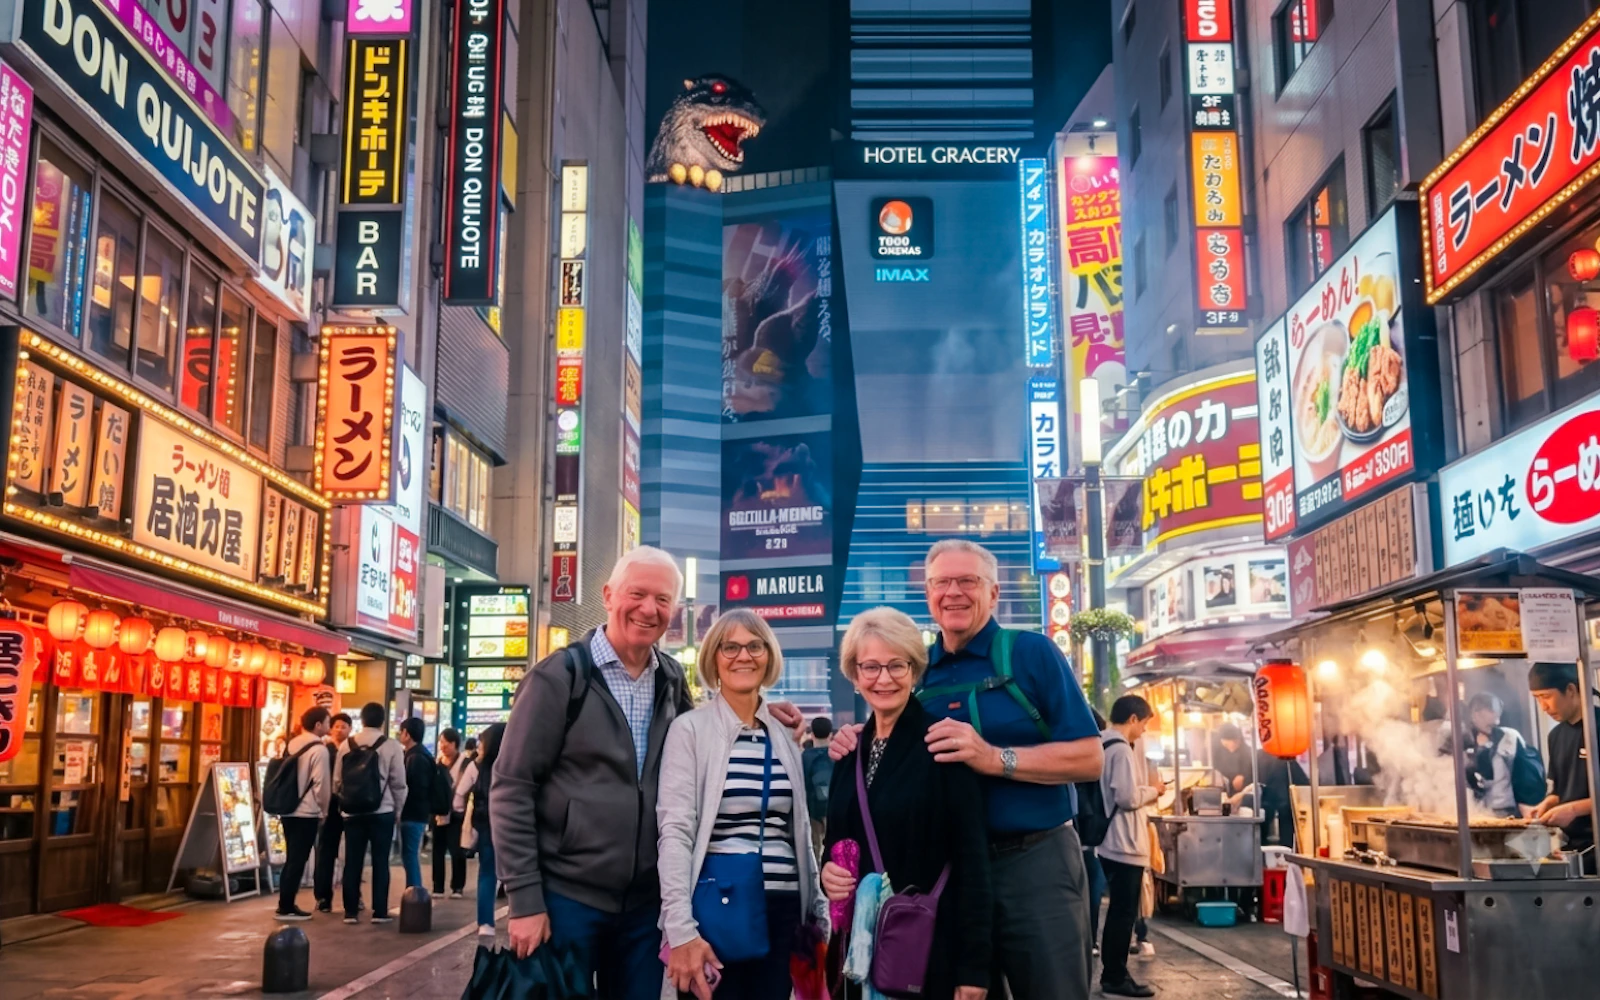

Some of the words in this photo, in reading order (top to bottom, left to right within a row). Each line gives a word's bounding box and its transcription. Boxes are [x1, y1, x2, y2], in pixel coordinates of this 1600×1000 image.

[43, 0, 128, 109] DON
[137, 82, 256, 238] QUIJOTE
[465, 127, 484, 173] DON
[864, 147, 927, 164] HOTEL
[931, 147, 1021, 164] GRACERY
[461, 177, 482, 269] QUIJOTE
[1449, 113, 1556, 251] ラーメン
[355, 220, 380, 296] BAR
[876, 268, 930, 281] IMAX
[1028, 229, 1048, 357] カラオケランド
[60, 393, 86, 493] ラーメン
[333, 346, 378, 481] ラーメン
